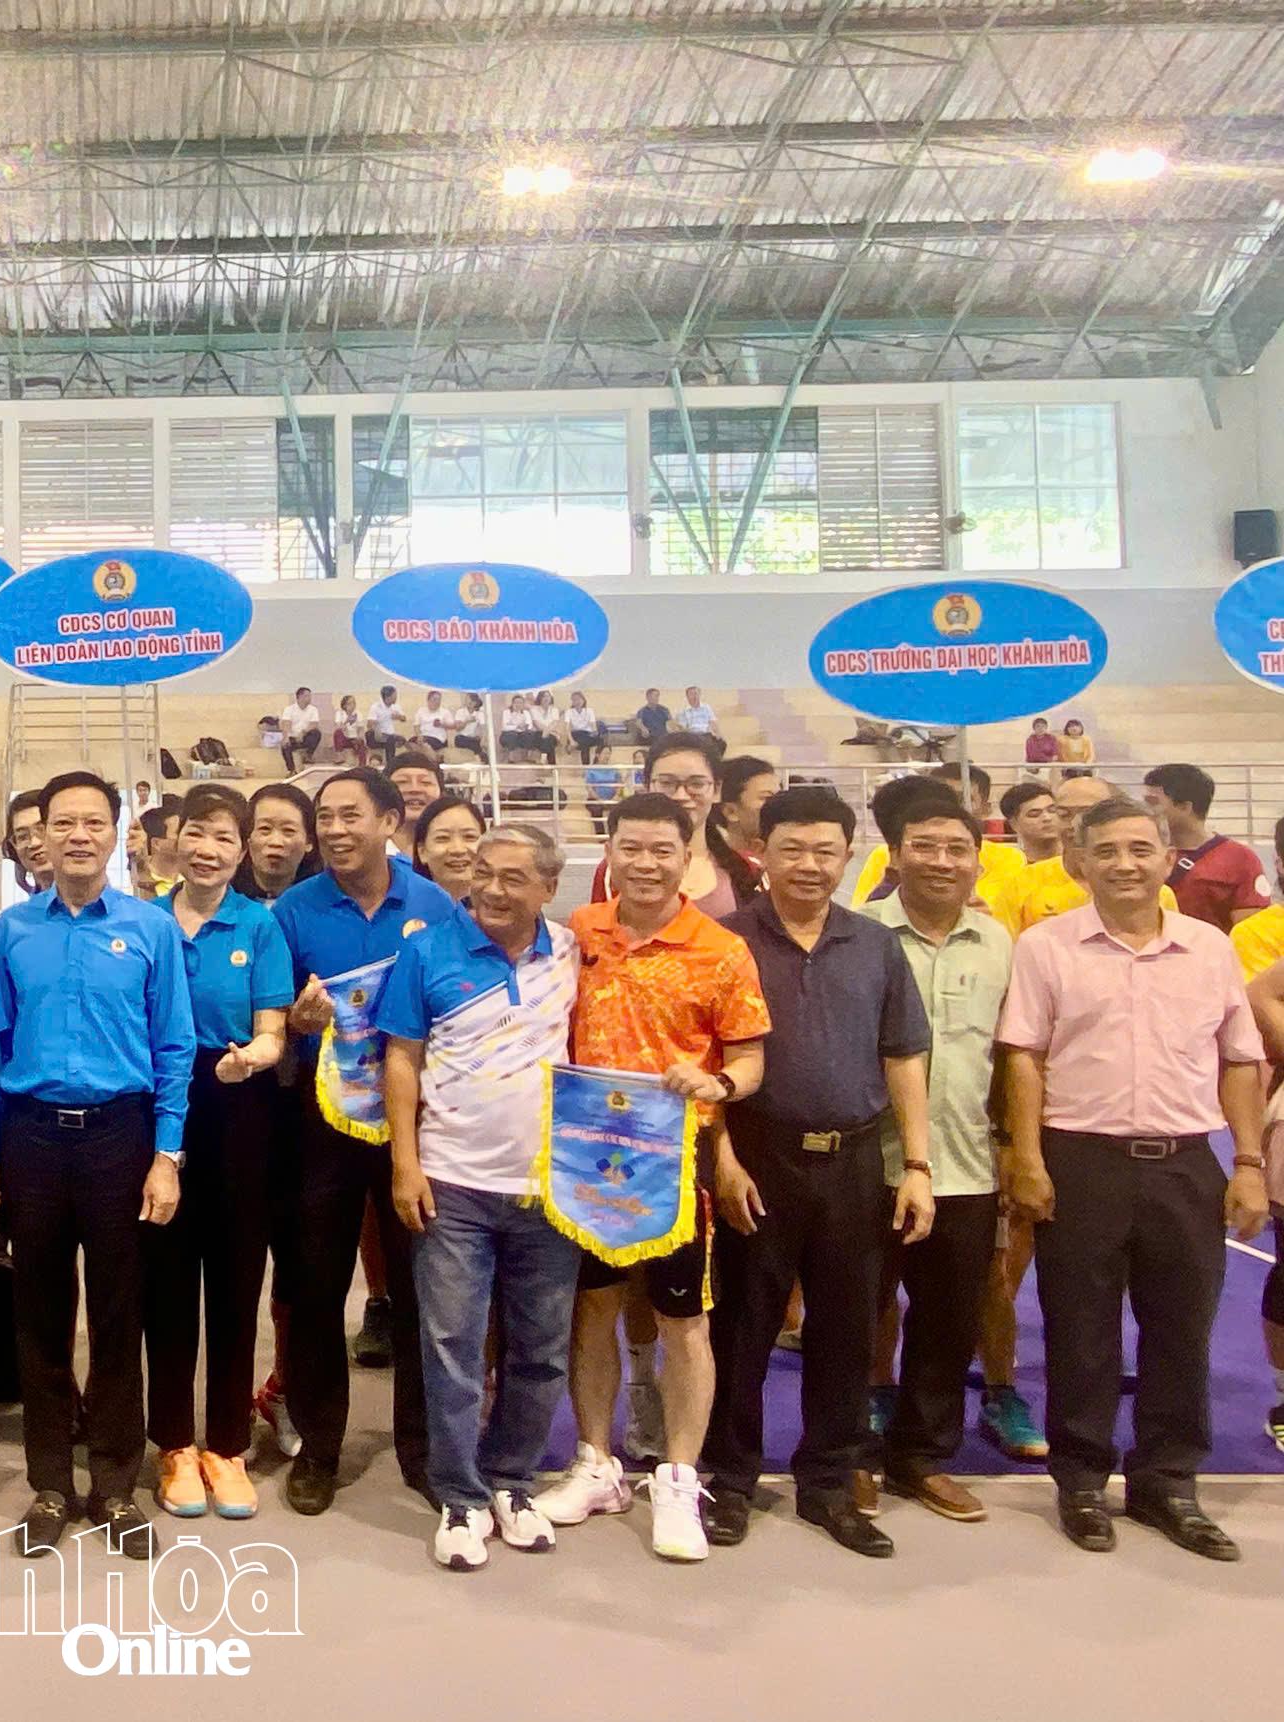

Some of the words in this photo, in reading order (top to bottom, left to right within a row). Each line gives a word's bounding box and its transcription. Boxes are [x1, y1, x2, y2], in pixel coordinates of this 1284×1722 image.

[106, 611, 127, 630] CƠ
[132, 609, 174, 630] QUAN
[436, 617, 473, 641] BÁO
[477, 617, 537, 641] KHÁNH
[540, 618, 577, 642] HÒA
[16, 643, 52, 665] LIÊN
[104, 641, 132, 659] LAO
[136, 635, 180, 660] ĐỘNG
[185, 630, 222, 652] TỈNH
[871, 643, 932, 672] TRƯỜNG
[967, 646, 998, 673] HỌC
[1002, 639, 1054, 665] KHÁNH
[1058, 637, 1089, 663] HÒA
